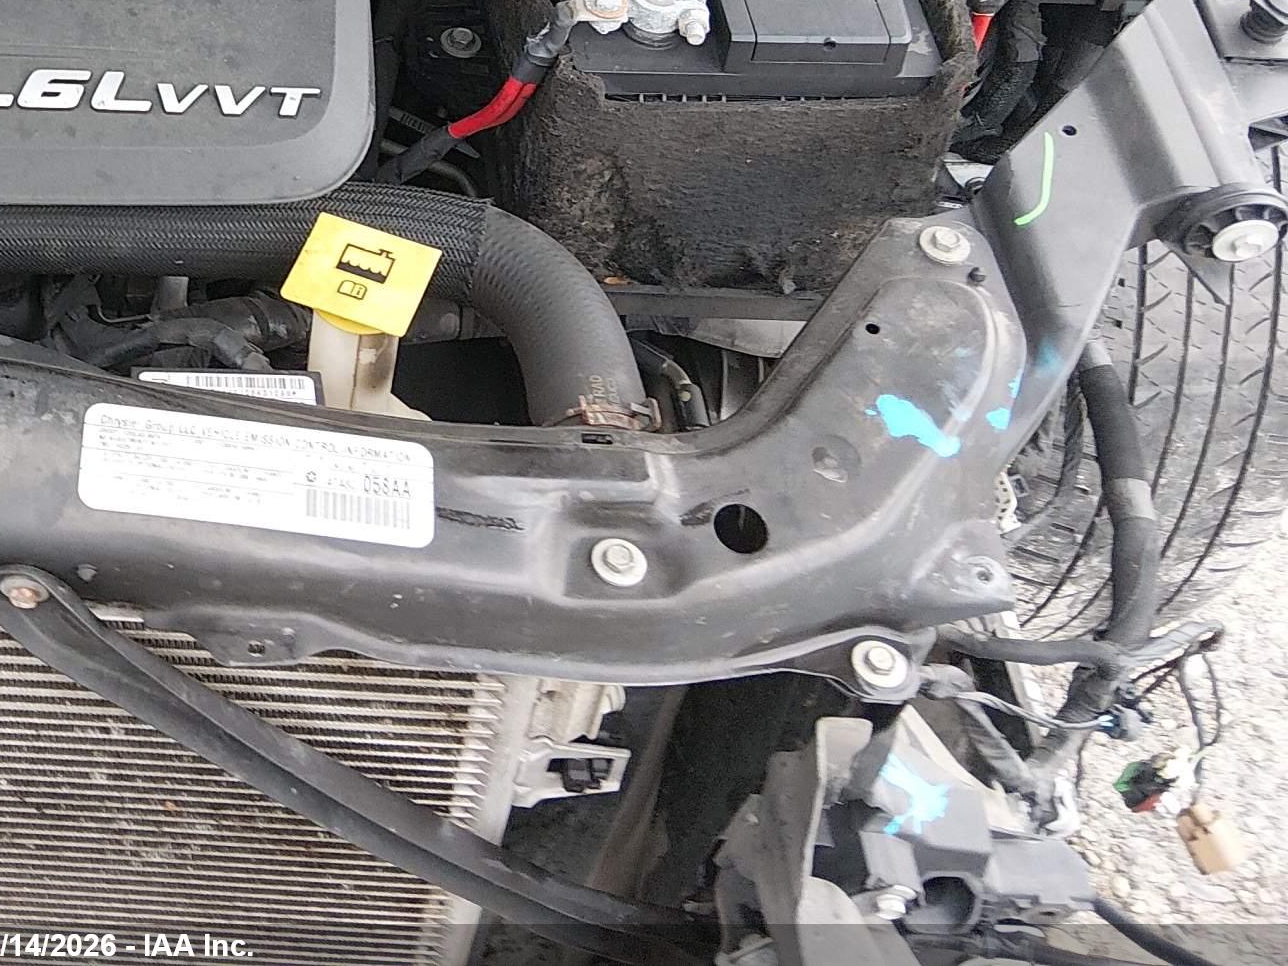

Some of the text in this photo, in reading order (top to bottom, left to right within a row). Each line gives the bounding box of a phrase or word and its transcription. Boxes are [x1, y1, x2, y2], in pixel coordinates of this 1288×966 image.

[145, 419, 173, 435] Group
[244, 432, 291, 448] EMISSION
[346, 445, 412, 463] INFORMATION
